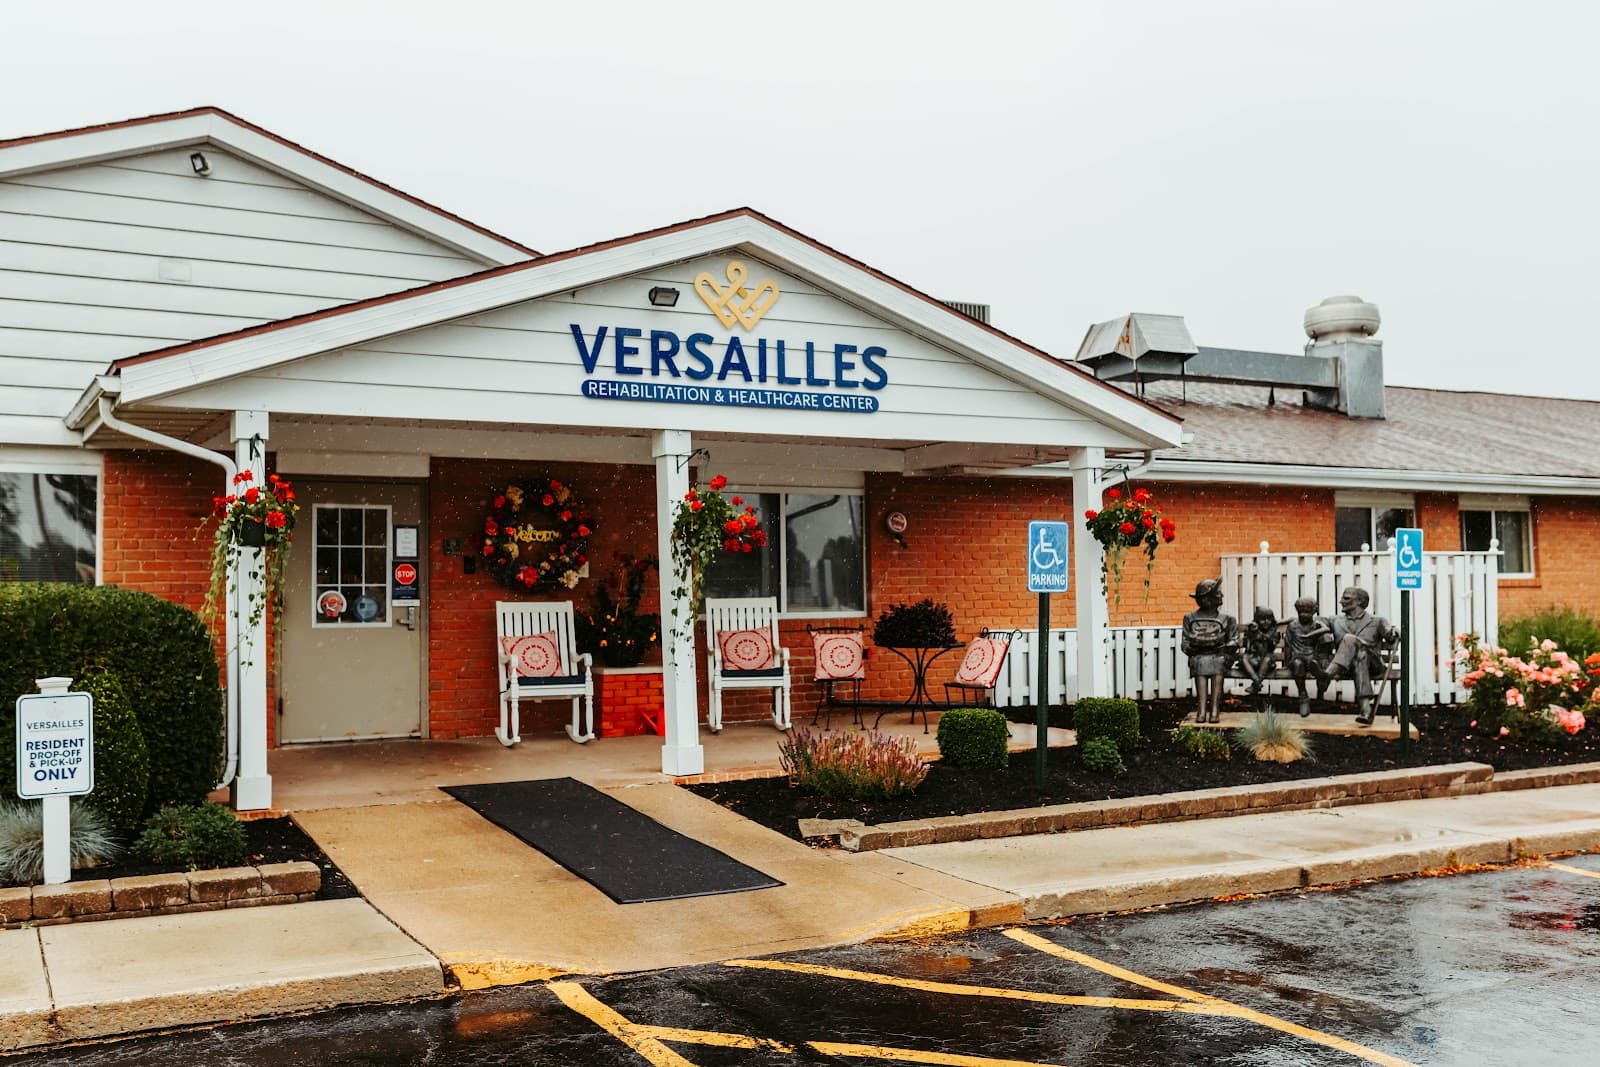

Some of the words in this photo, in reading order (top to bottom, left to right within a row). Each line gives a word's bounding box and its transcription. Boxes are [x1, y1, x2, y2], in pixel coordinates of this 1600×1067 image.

[570, 324, 888, 390] VERSAILLES
[588, 381, 710, 401] REHABILITATION
[715, 390, 724, 401] &
[729, 391, 818, 407] HEALTHCARE
[822, 395, 873, 410] CENTER
[397, 570, 415, 578] STOP
[1031, 574, 1065, 585] PARKING
[26, 720, 84, 730] VERSAILLES
[26, 739, 84, 751] RESIDENT
[30, 750, 81, 760] DROP-OFF
[40, 758, 82, 767] PICK-UP
[34, 767, 77, 781] ONLY
